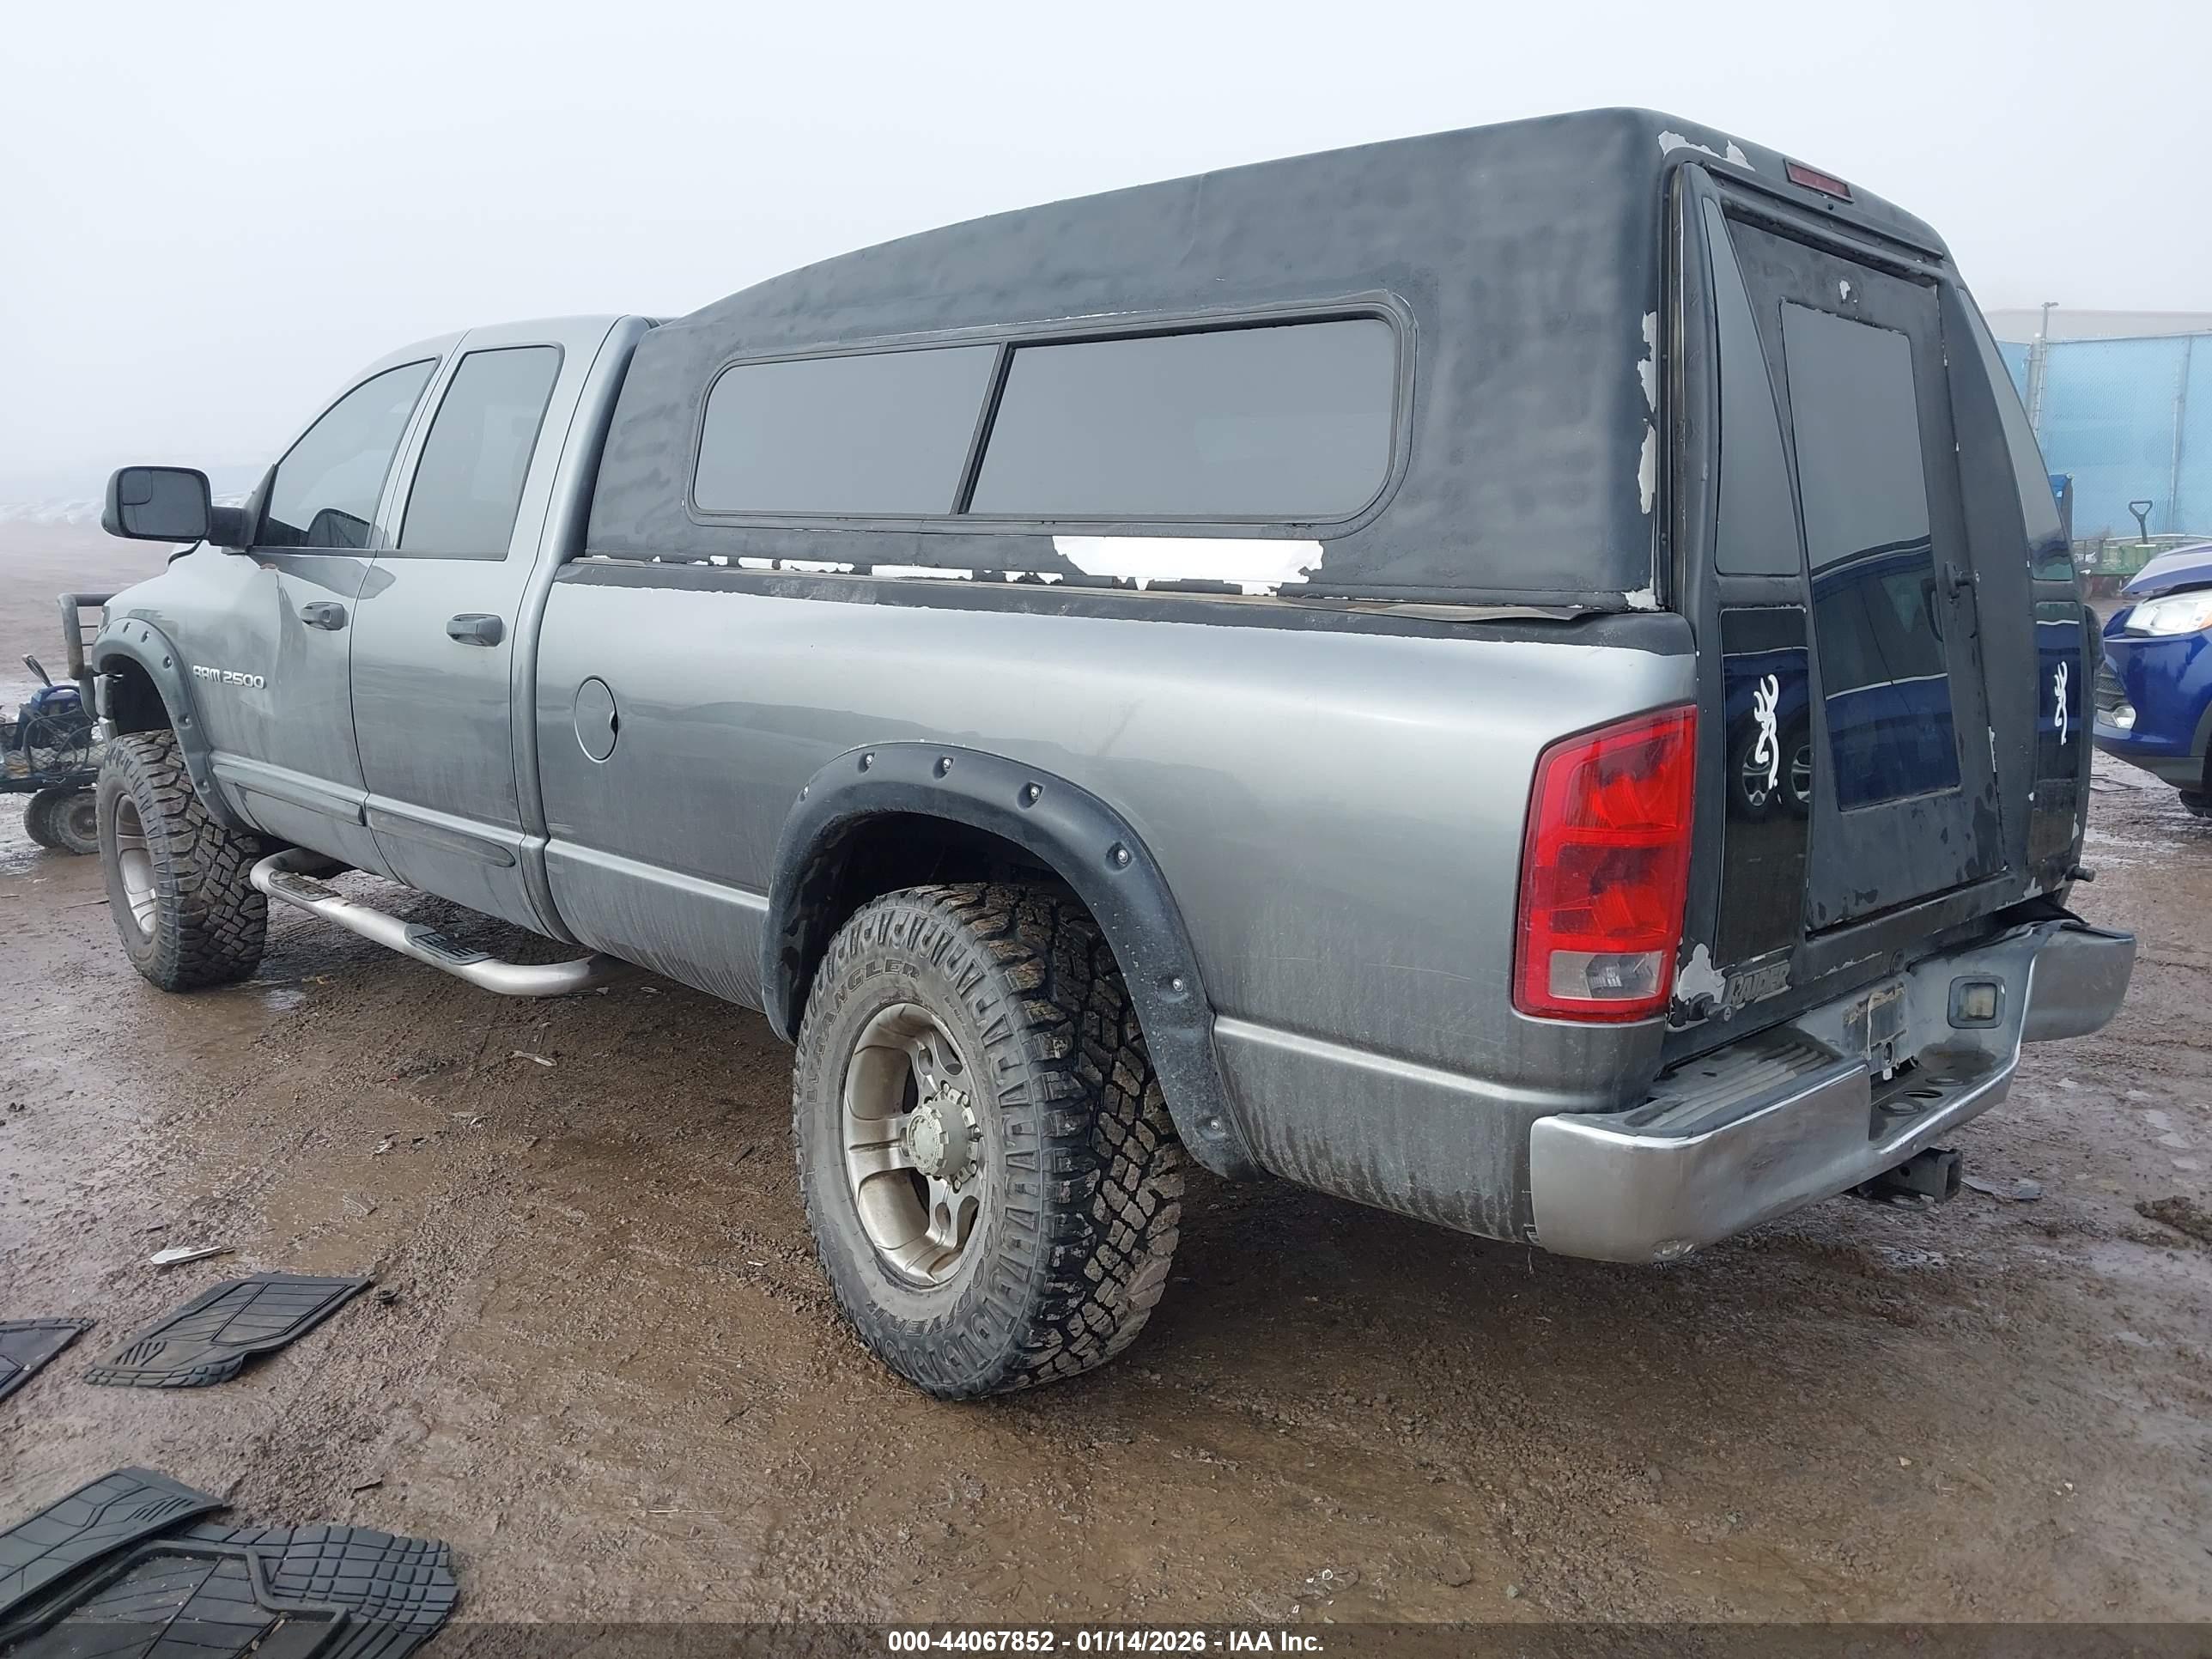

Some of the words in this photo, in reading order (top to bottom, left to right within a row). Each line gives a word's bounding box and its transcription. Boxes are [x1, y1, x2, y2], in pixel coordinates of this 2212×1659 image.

[192, 665, 222, 683] RAM
[222, 670, 264, 689] 2500
[1722, 960, 1791, 1008] RAIDER
